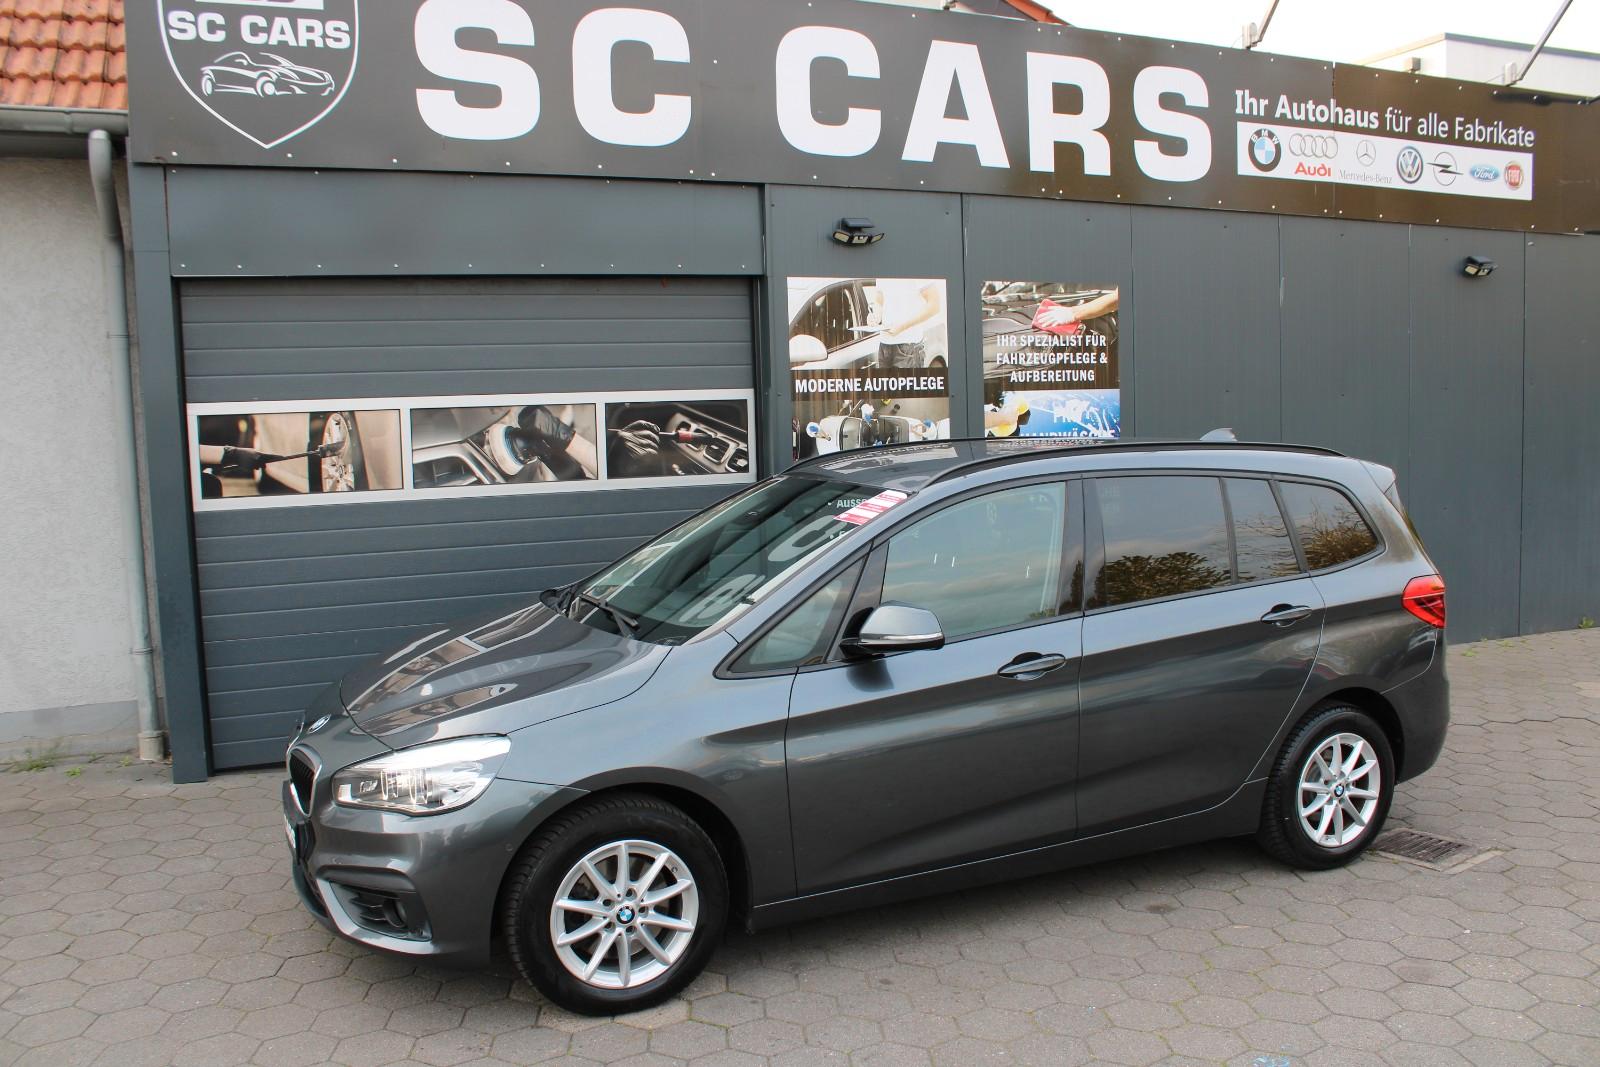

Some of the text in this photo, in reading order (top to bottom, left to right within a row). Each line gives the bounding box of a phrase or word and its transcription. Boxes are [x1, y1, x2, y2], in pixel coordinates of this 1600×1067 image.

[167, 10, 351, 49] SC CARS
[414, 0, 1212, 182] SC CARS
[1235, 89, 1535, 148] Ihr Autohaus für alle Fabrikate
[1294, 161, 1332, 178] Audi
[997, 333, 1106, 347] IHR SPEZIALIST FÜR
[996, 352, 1108, 365] FAHRZEUGPFLEGE &
[795, 376, 945, 393] MODERNE AUTOPFLEGE
[1010, 369, 1095, 383] AUFBEREITUNG
